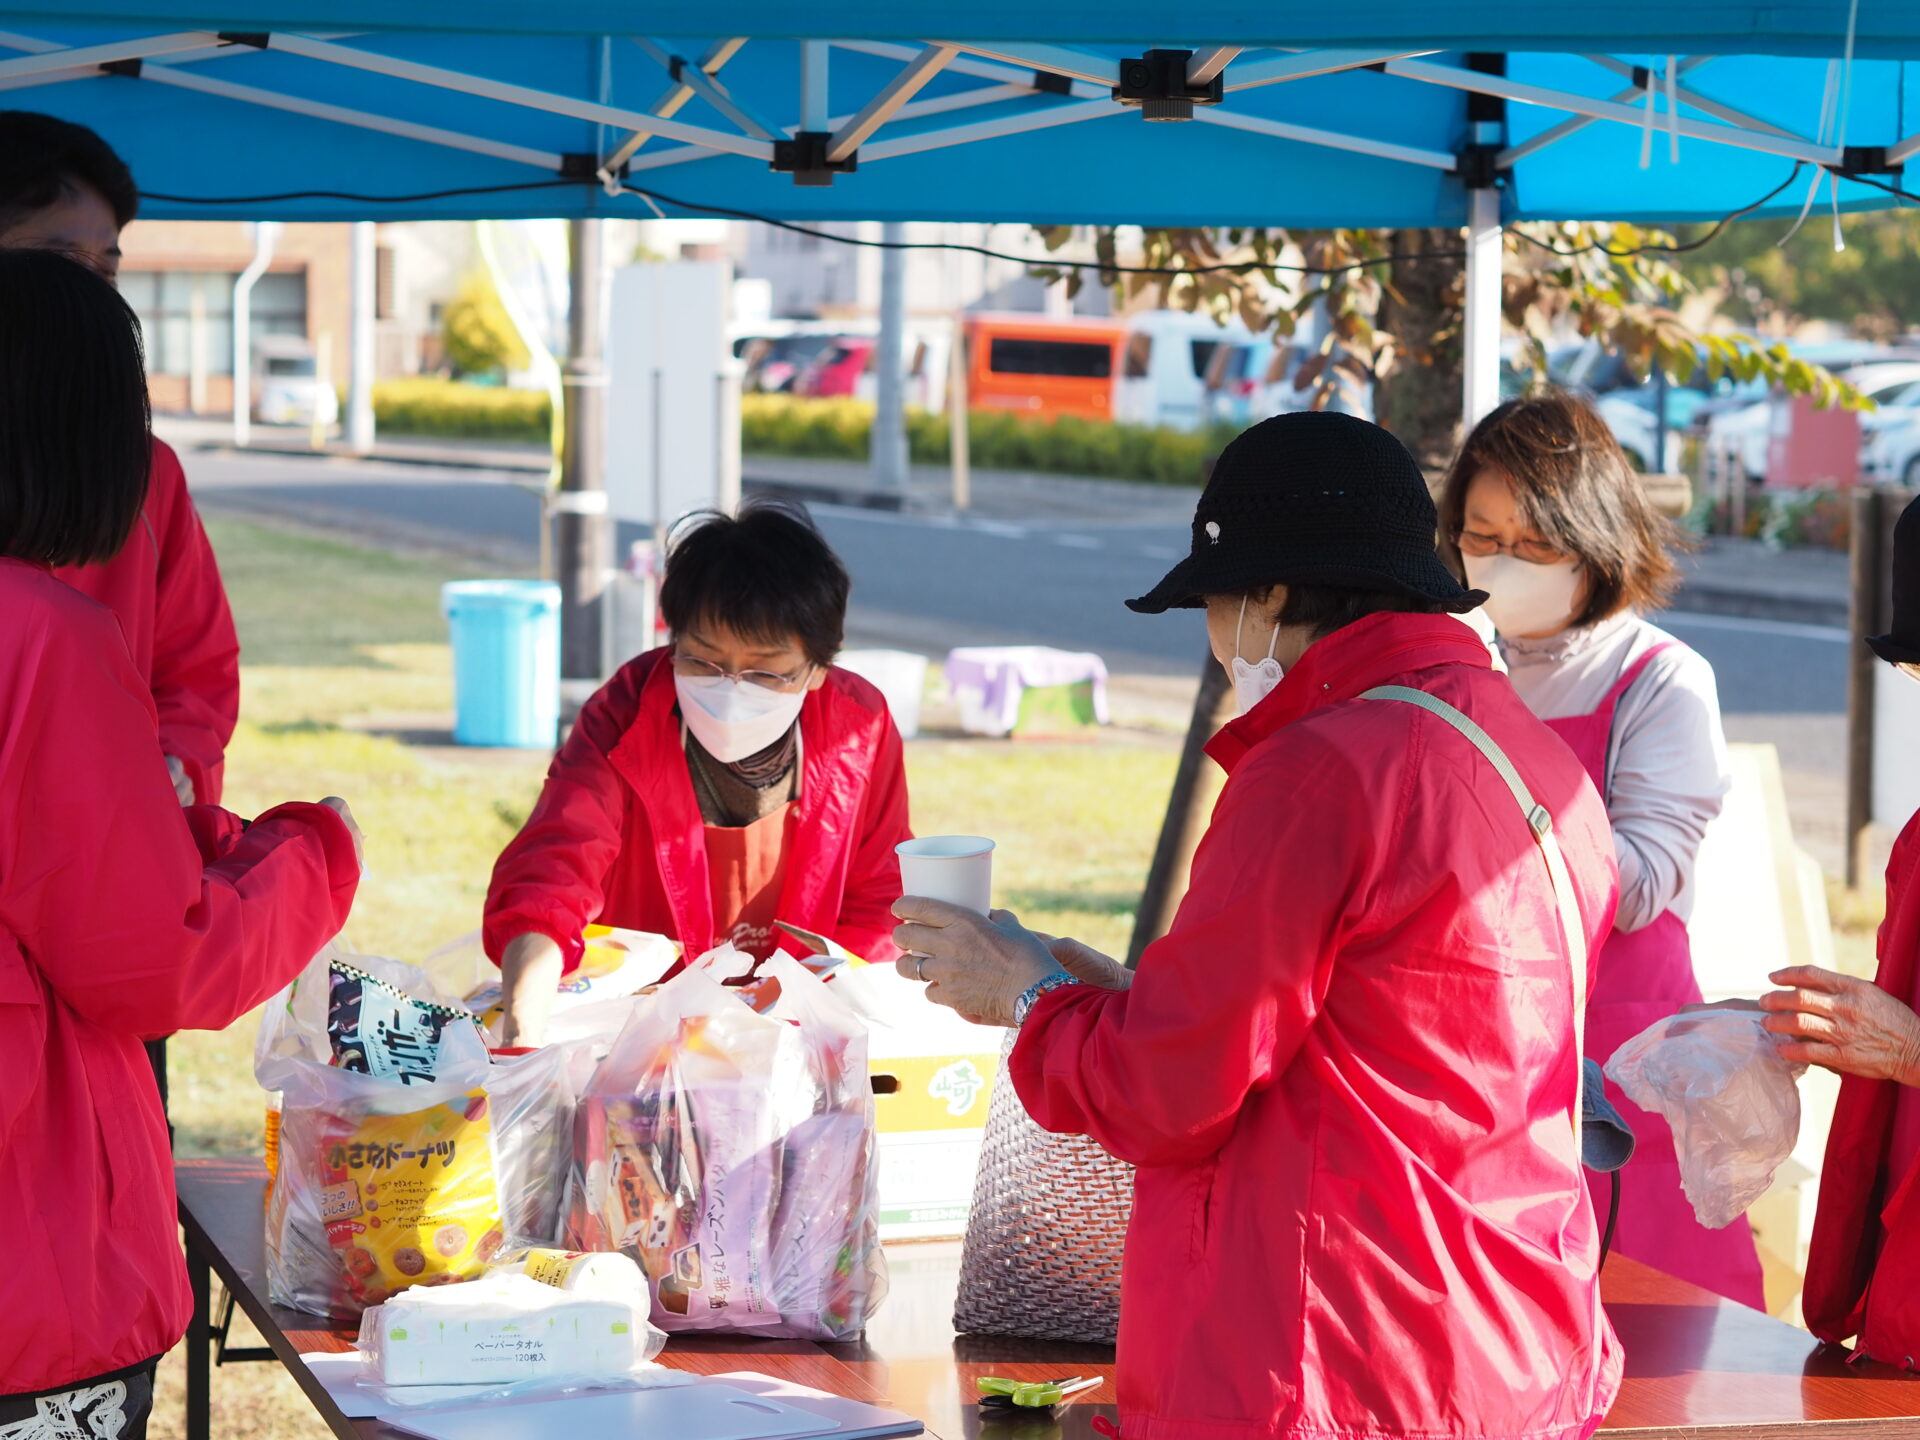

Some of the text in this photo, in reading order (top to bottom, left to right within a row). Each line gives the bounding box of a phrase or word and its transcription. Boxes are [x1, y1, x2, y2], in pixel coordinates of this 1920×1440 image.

[936, 1065, 978, 1110] 崎
[328, 1140, 455, 1169] 小さなドーナツ
[474, 1340, 544, 1350] ペーパータオル
[515, 1353, 547, 1362] 120枚入
